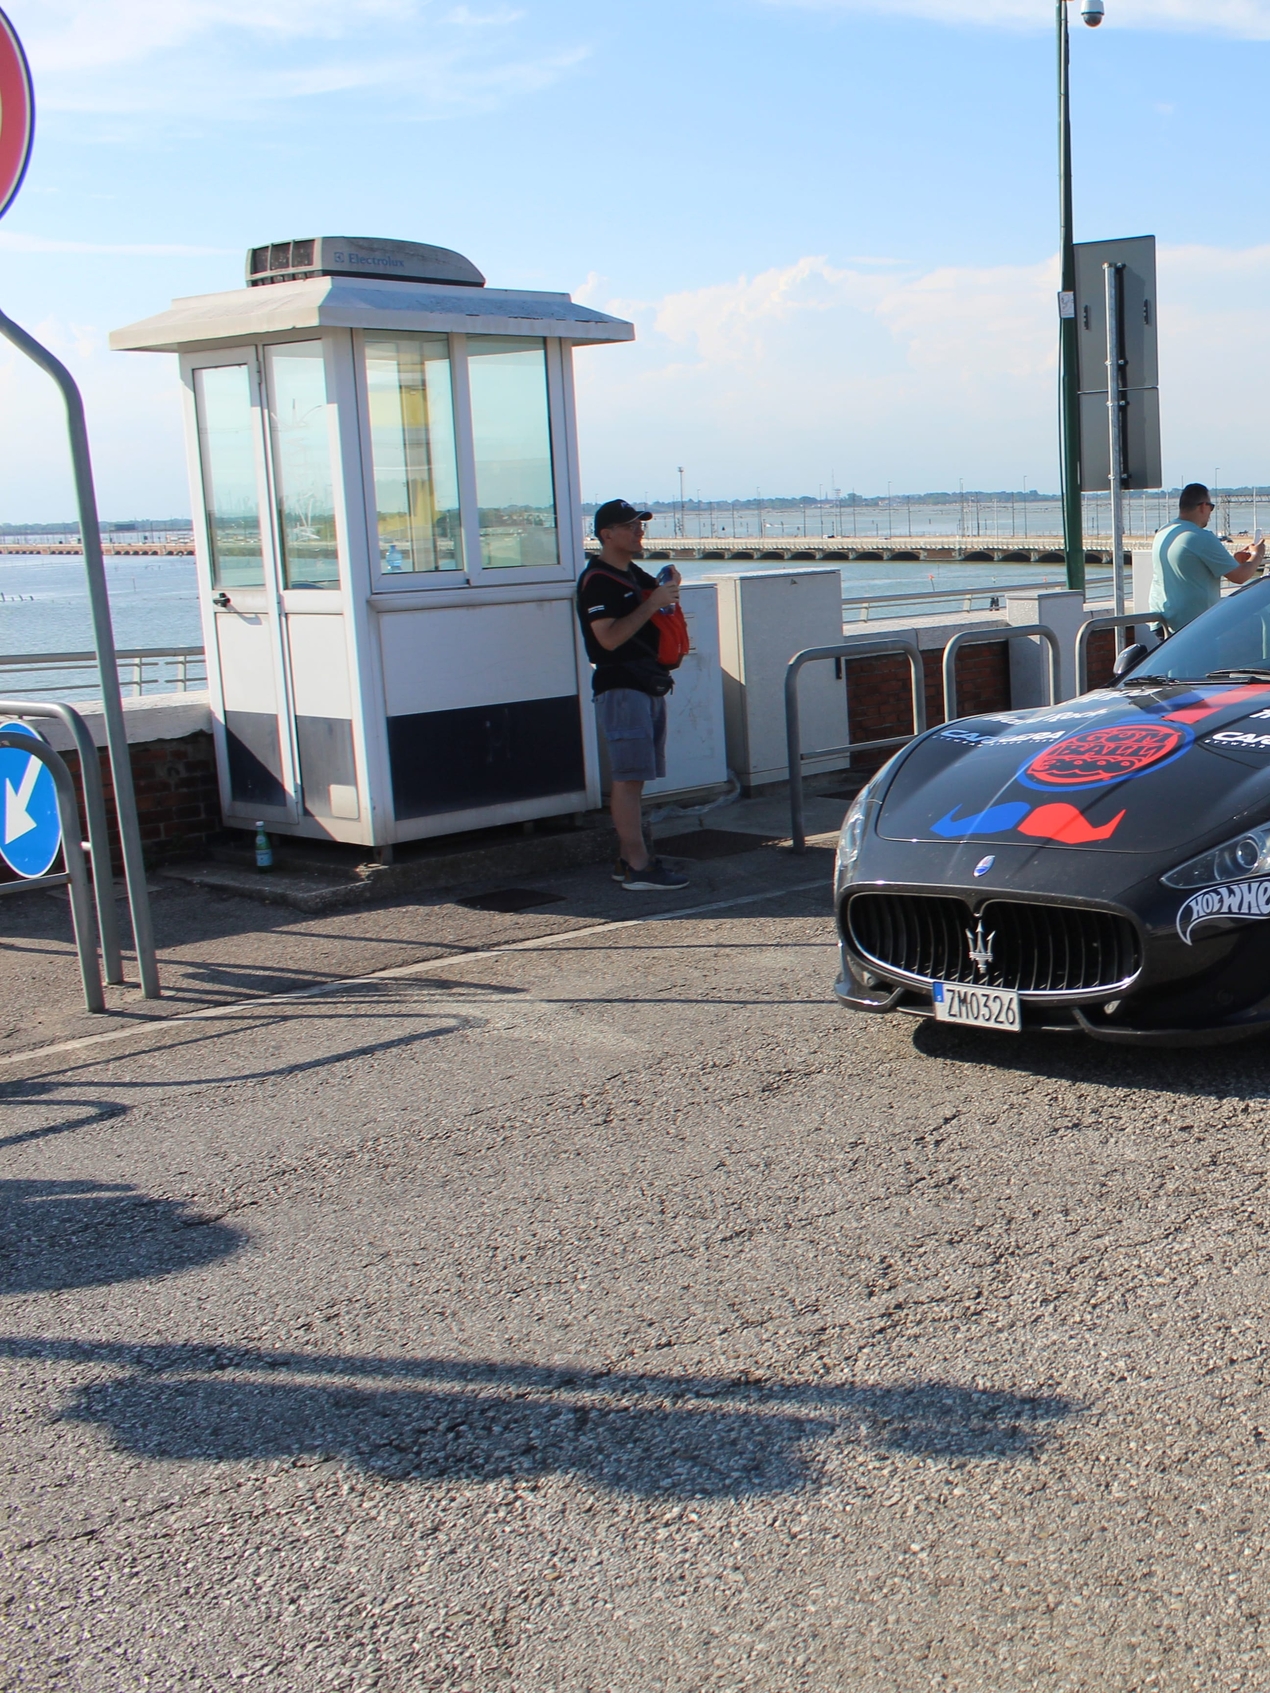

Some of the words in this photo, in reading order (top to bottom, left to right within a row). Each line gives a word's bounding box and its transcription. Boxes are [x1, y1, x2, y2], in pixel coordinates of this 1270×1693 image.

[348, 252, 405, 267] Electrolux
[940, 730, 1066, 744] CARRERA
[1049, 744, 1165, 757] BALL
[1032, 759, 1138, 776] 3000
